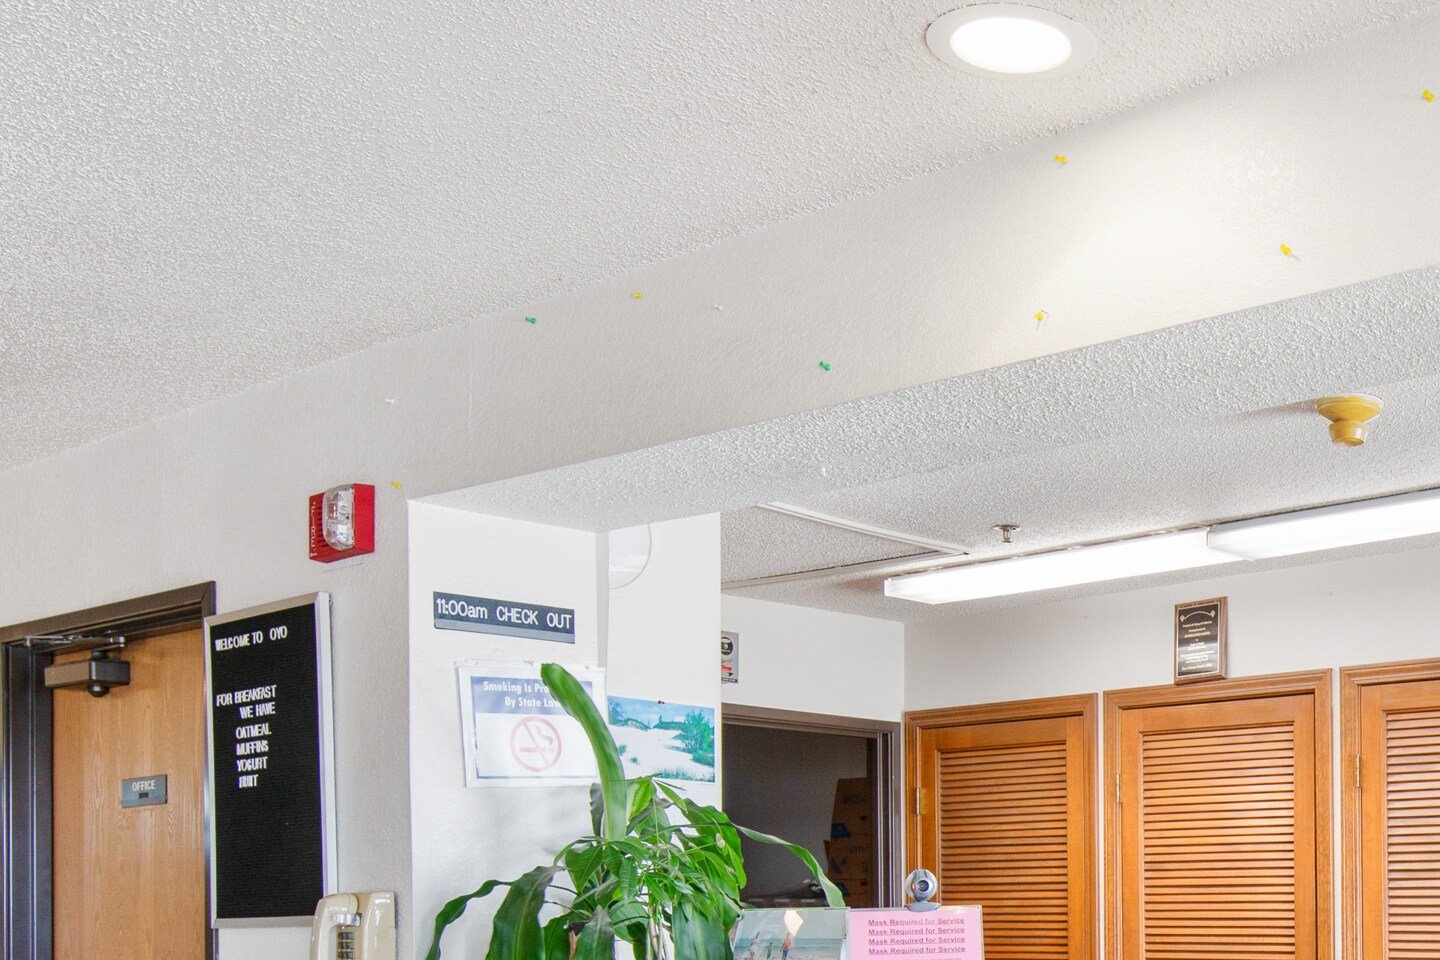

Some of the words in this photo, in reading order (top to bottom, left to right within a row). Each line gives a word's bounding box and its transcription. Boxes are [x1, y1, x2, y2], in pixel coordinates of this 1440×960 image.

[436, 598, 488, 619] 11:00am
[496, 606, 539, 625] CHECK
[546, 612, 572, 629] OUT
[215, 633, 250, 652] WELCOME
[251, 630, 263, 644] TO
[269, 625, 288, 641] OYO
[483, 681, 521, 694] Smoking
[524, 683, 531, 693] Is
[216, 692, 233, 707] FOR
[234, 685, 277, 704] BREAKFAST
[504, 697, 516, 708] By
[518, 697, 542, 707] State
[240, 705, 254, 719] WE
[255, 702, 276, 717] HAVE
[235, 722, 272, 739] OATMEAL
[236, 740, 269, 756] MUFFINS
[236, 756, 268, 772] YOGURT
[132, 780, 156, 791] OFFICE
